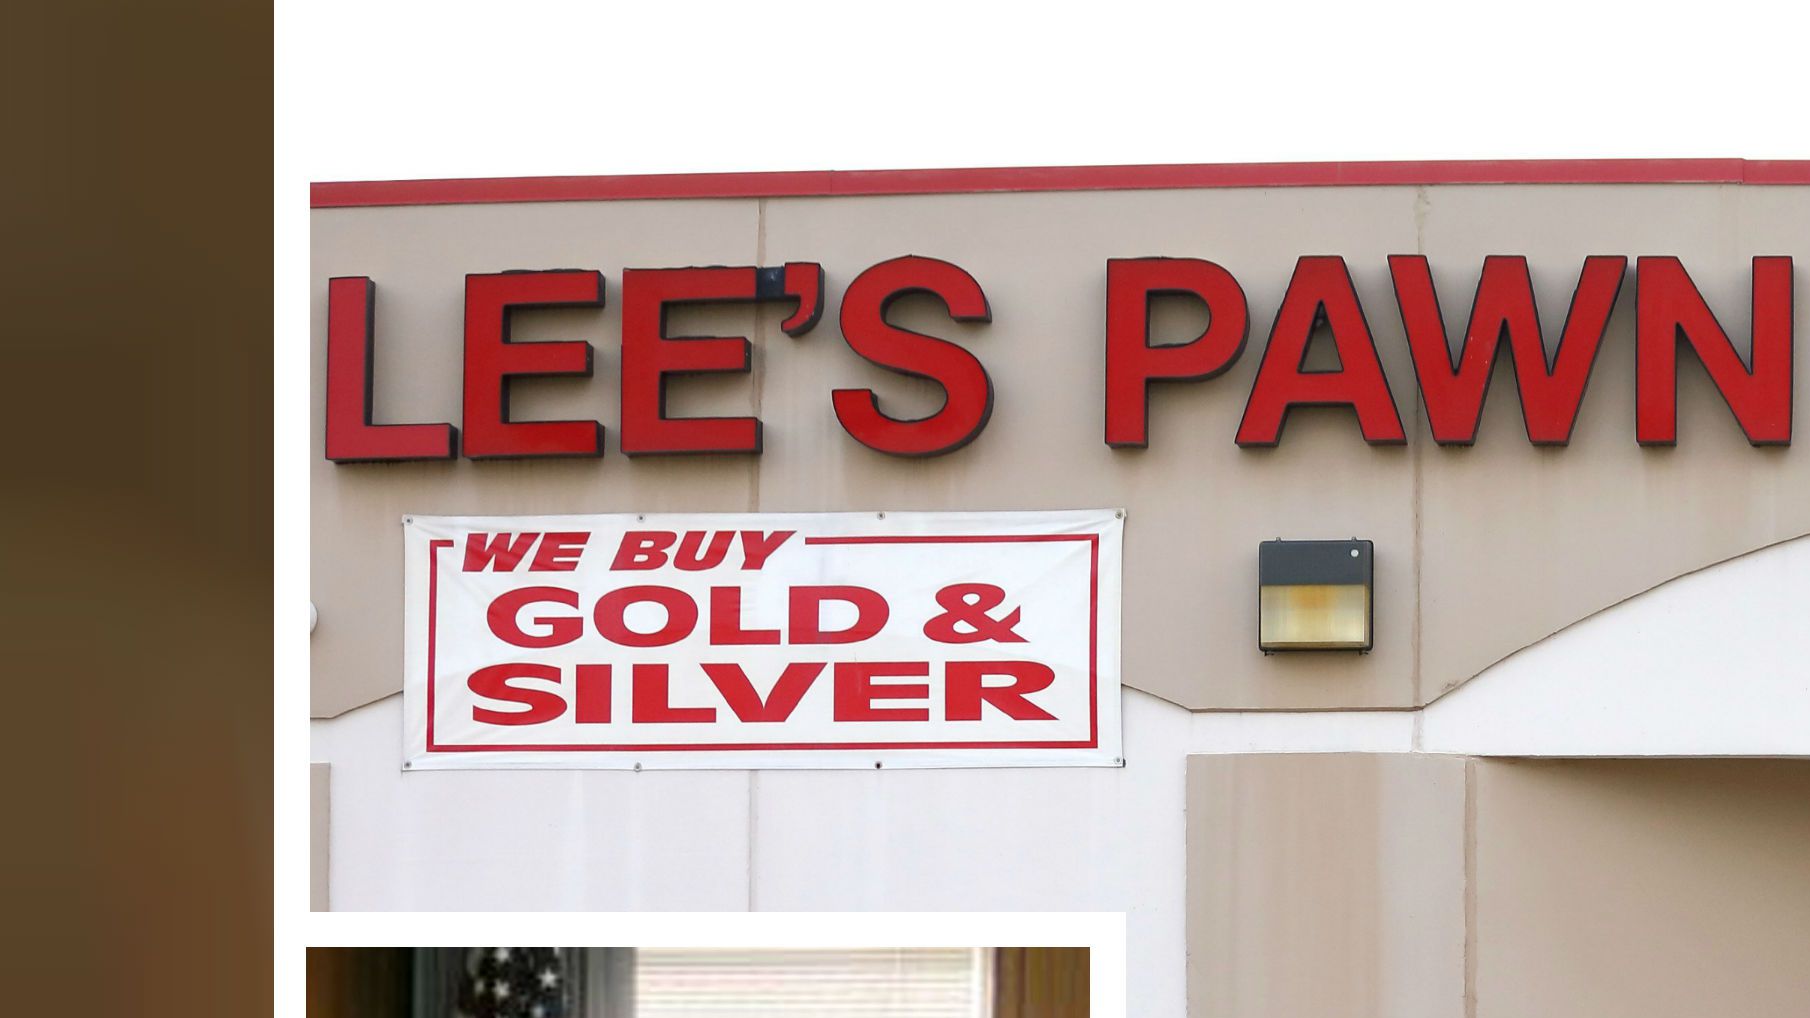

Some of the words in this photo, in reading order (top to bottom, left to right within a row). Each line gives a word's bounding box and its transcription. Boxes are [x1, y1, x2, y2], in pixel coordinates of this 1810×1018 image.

[325, 255, 993, 462] LEE'S
[1105, 255, 1793, 446] PAWN
[462, 530, 591, 573] WE
[609, 530, 796, 572] BUY
[486, 584, 890, 649] GOLD
[922, 582, 1030, 645] &
[466, 660, 1060, 726] SILVER
